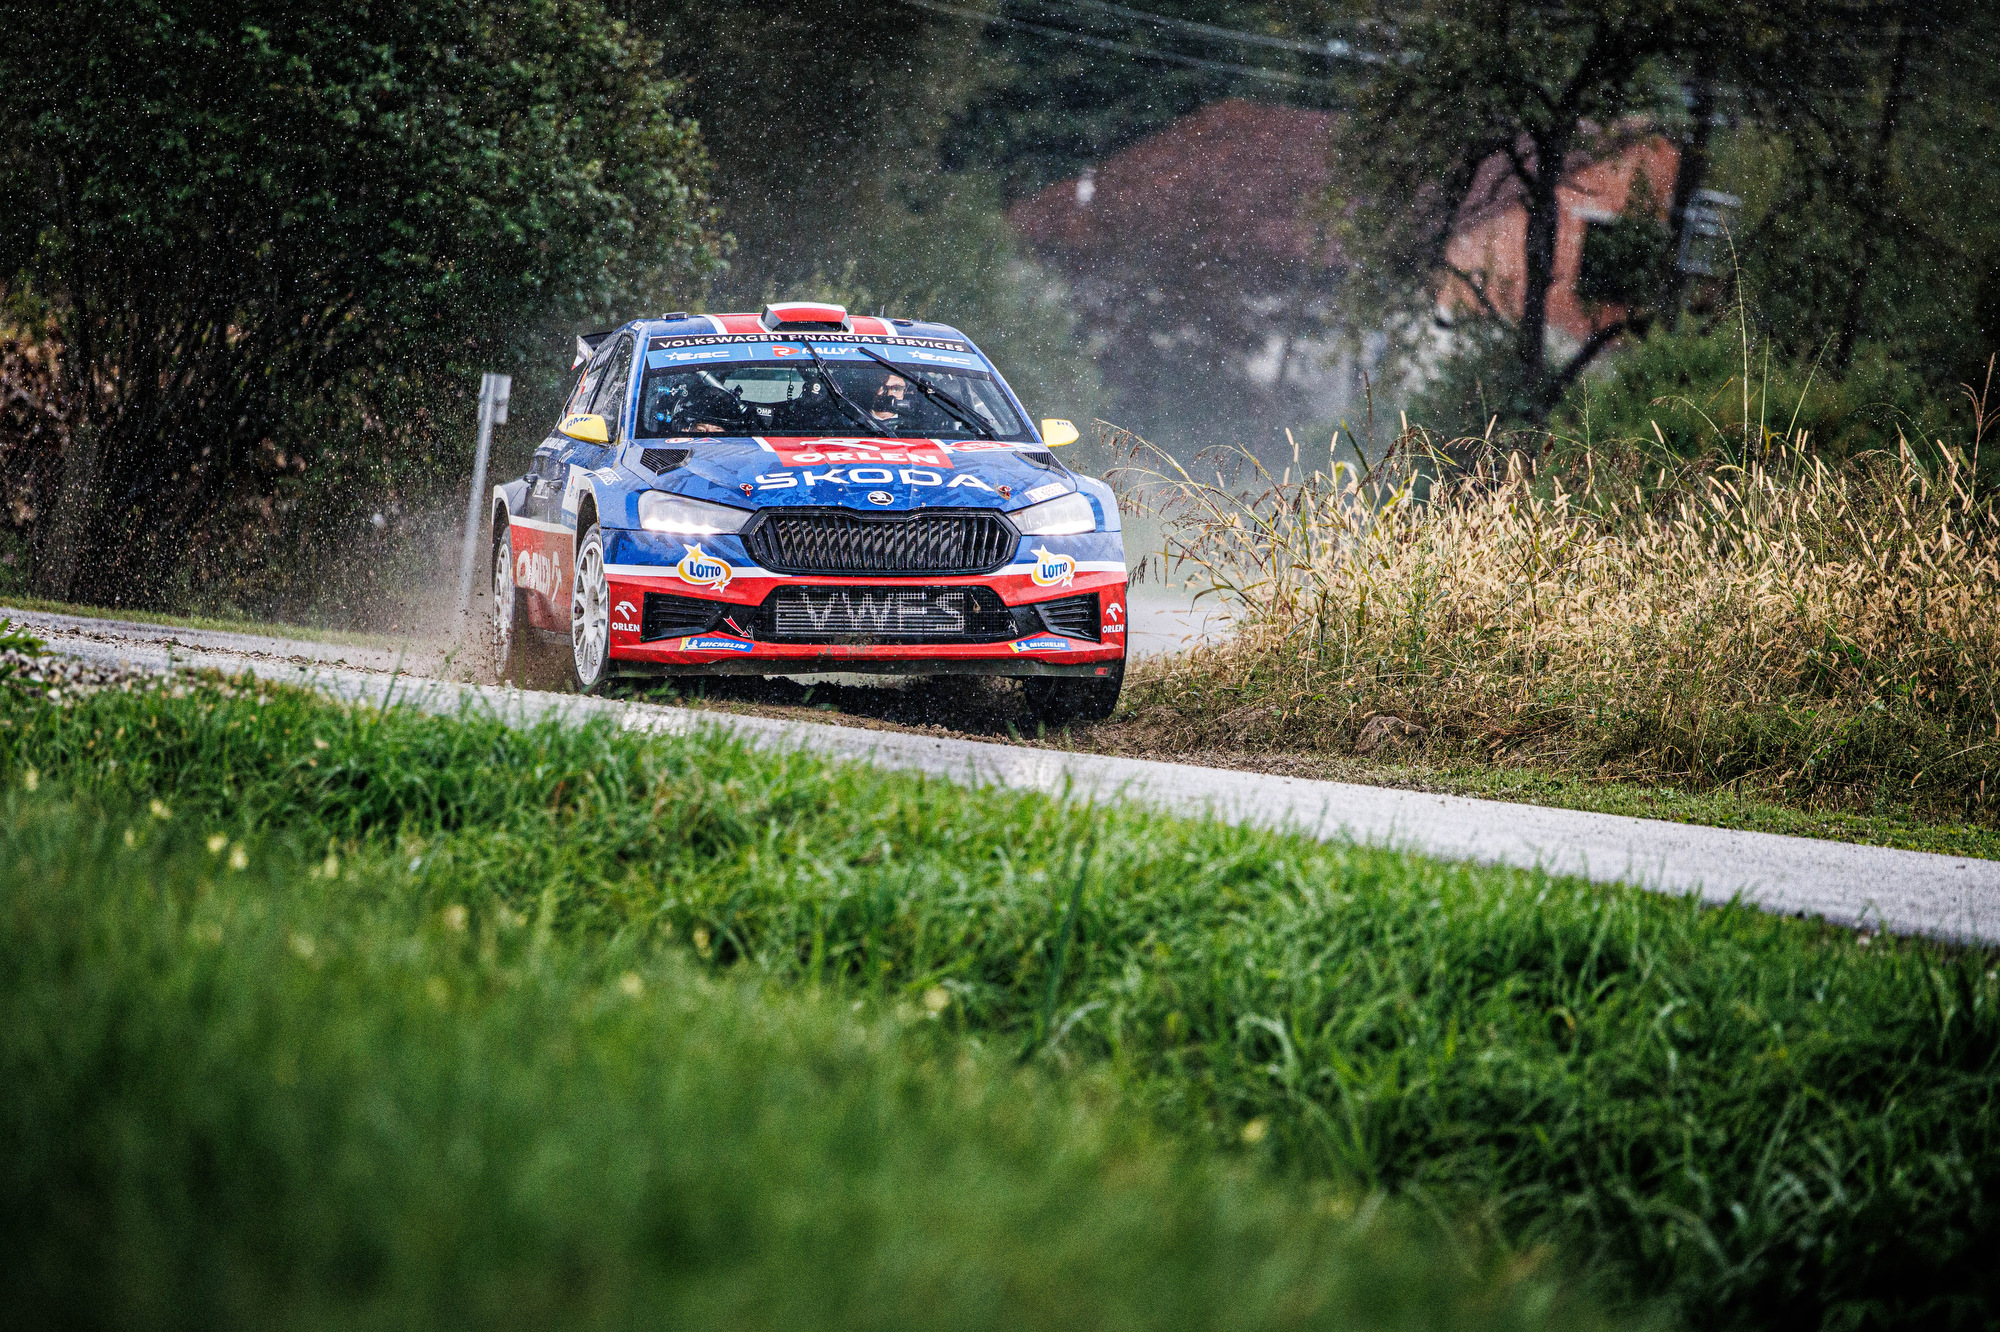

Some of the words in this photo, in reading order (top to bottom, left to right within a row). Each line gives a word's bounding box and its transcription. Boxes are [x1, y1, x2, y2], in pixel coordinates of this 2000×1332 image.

[658, 334, 782, 349] VOLKSWAGEN
[885, 337, 965, 352] SERVICES
[792, 452, 940, 465] ORLEN
[689, 561, 721, 578] LOTTO
[1042, 562, 1068, 579] LOTTO
[611, 622, 640, 632] ORLEN
[1102, 624, 1124, 634] ORLEN
[699, 641, 748, 650] MICHELIN
